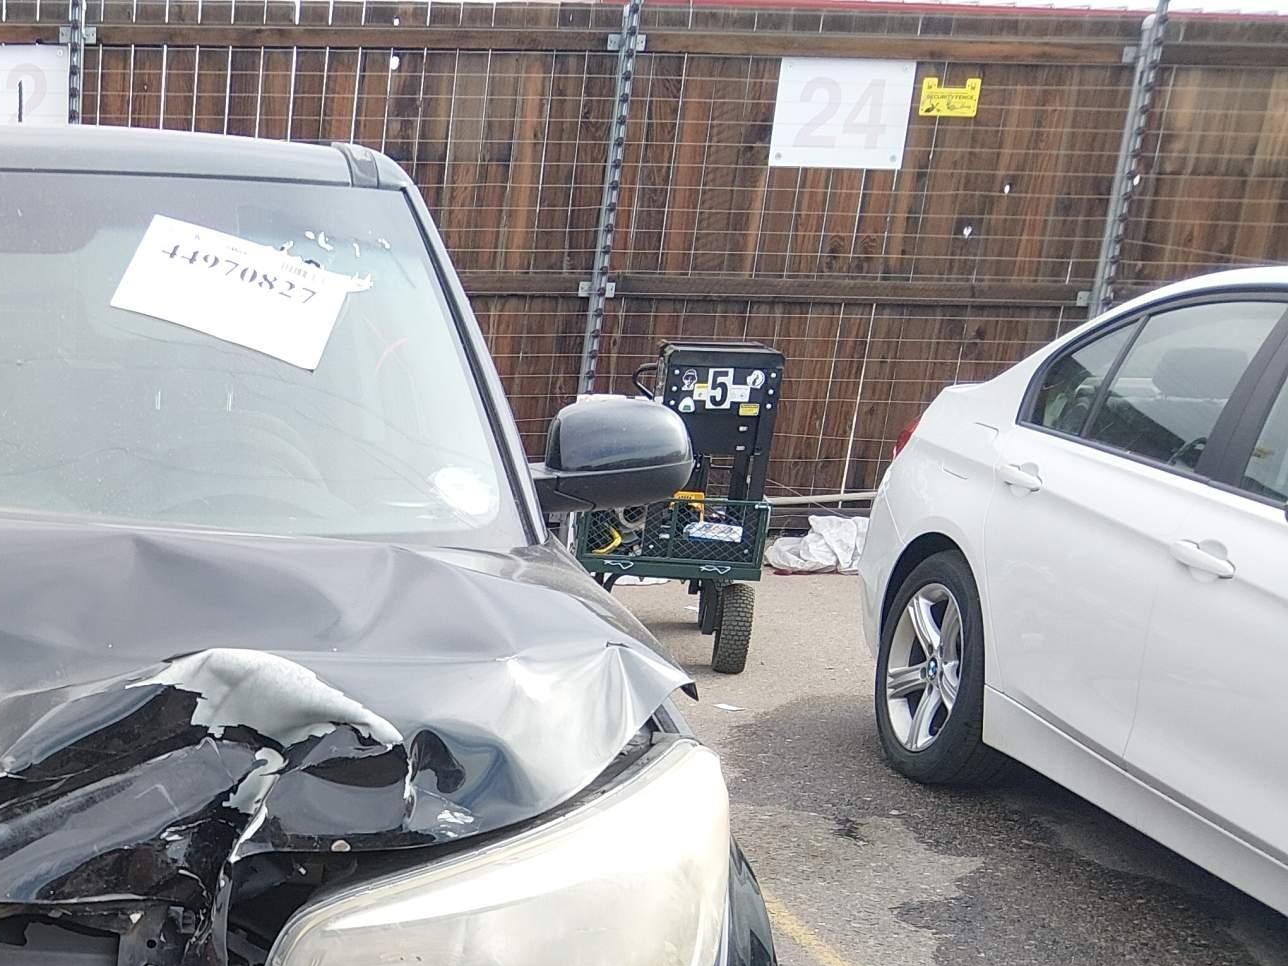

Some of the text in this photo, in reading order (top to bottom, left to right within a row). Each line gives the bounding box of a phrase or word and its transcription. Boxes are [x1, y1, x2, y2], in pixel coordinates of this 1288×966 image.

[792, 76, 888, 149] 24
[161, 244, 317, 304] 44970827
[709, 370, 729, 407] 5
